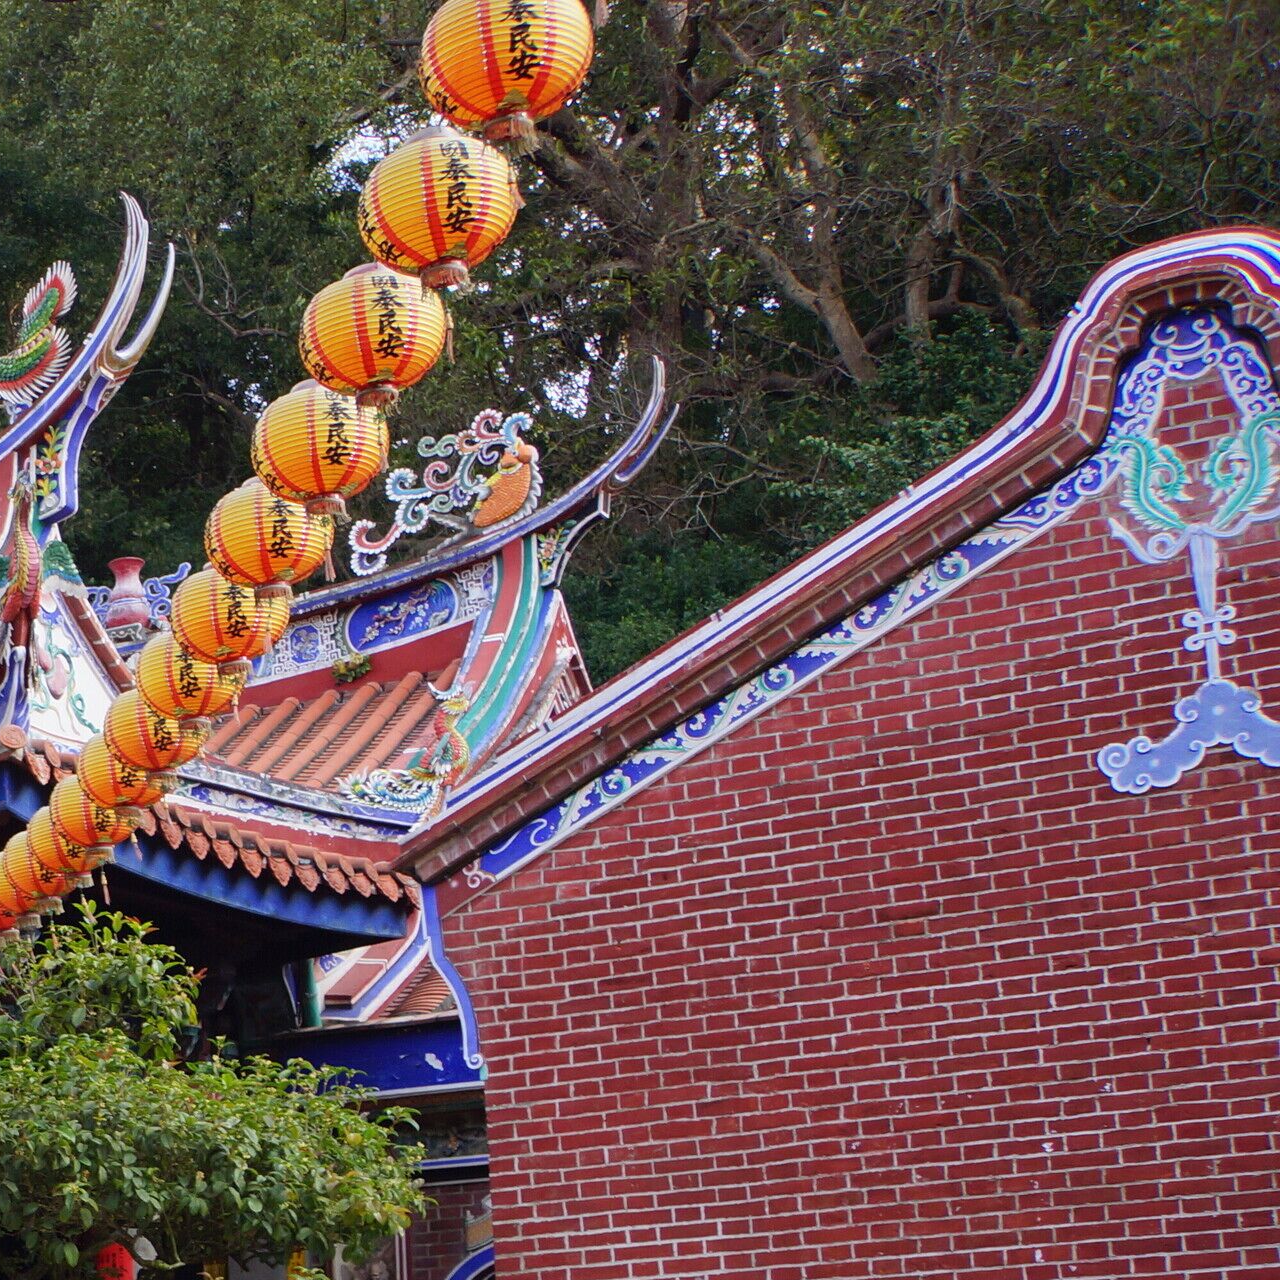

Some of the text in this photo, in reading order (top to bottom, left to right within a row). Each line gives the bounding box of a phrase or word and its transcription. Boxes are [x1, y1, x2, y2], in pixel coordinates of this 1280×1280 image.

[437, 140, 476, 234] 國泰民安
[371, 275, 405, 359] 國泰民安
